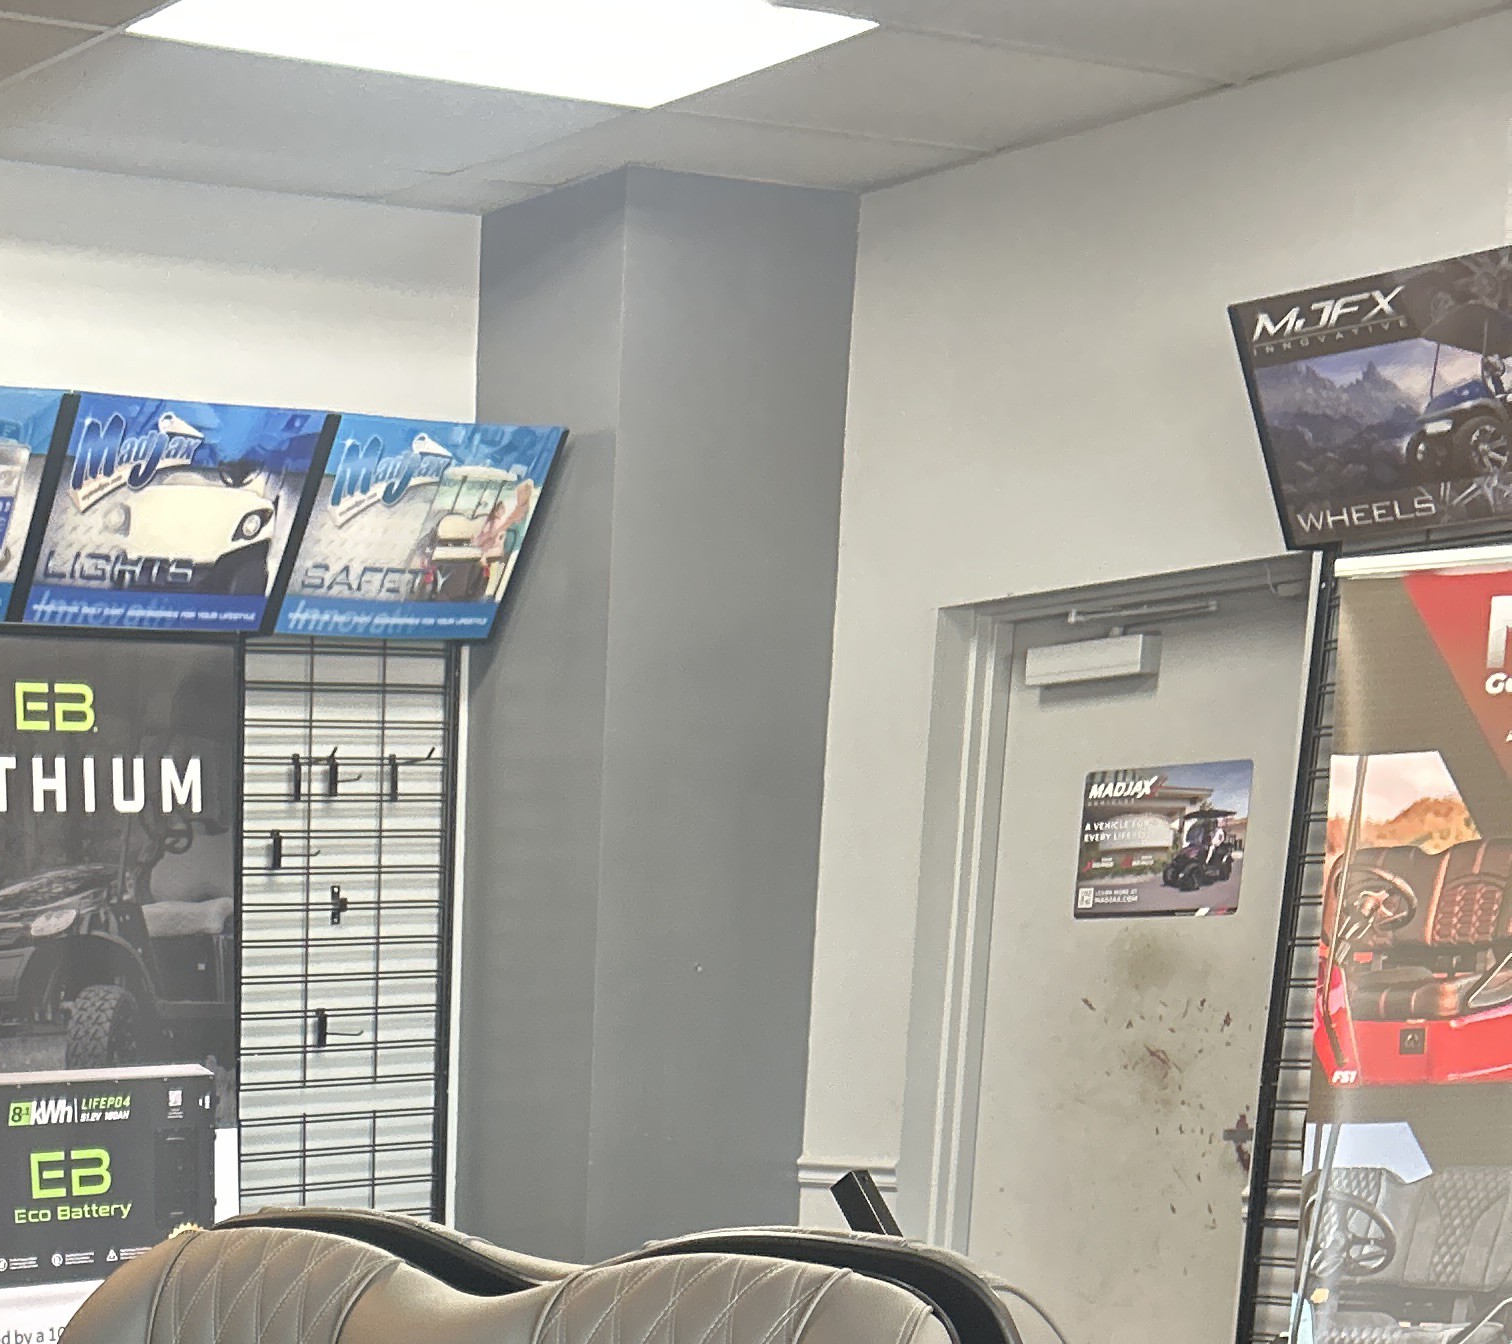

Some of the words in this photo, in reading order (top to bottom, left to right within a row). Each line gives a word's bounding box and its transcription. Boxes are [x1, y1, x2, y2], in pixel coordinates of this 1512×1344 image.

[1253, 319, 1407, 357] INNOVATIVE
[1297, 495, 1436, 532] WHEELS
[43, 549, 194, 588] LIGHTS
[301, 562, 452, 595] SAFETY
[15, 682, 95, 732] EB
[1088, 776, 1162, 799] MADJAX
[30, 1148, 112, 1199] EB
[14, 1208, 52, 1224] Eco
[56, 1203, 133, 1220] Battery
[36, 1331, 45, 1343] a
